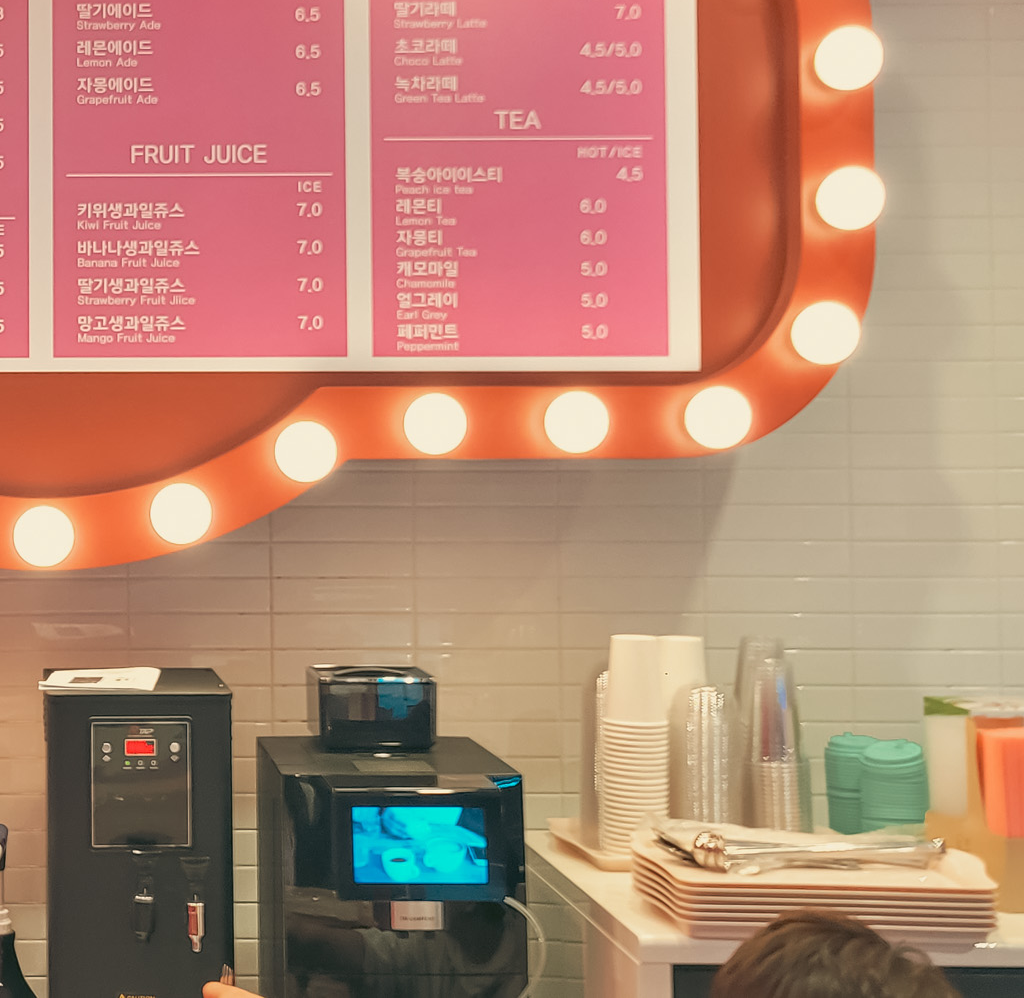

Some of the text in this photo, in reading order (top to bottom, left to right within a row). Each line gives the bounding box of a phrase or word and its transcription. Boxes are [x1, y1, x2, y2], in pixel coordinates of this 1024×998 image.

[77, 3, 152, 19] 딸기에이드
[295, 7, 320, 22] 6.5
[394, 1, 456, 17] 딸기라떼
[615, 4, 641, 20] 7.0
[77, 20, 161, 31] Strawberry Ade
[77, 40, 153, 55] 레몬에이드
[296, 44, 321, 59] 6.5
[395, 38, 457, 54] 초코라떼
[580, 42, 642, 58] 4.5/5.0
[77, 58, 137, 67] Lemon Ade
[77, 78, 154, 93] 자몽에이드
[296, 82, 321, 96] 6.5
[395, 76, 458, 92] 녹차라떼
[580, 79, 642, 95] 4.5/5.0
[77, 95, 158, 106] Grapefruit Ade
[494, 110, 541, 129] TEA
[131, 144, 267, 163] FRUIT JUICE
[578, 146, 642, 158] HOT/ICE
[616, 166, 643, 181] 4.5
[298, 181, 321, 192] ICE
[78, 203, 184, 219] 키위생과일쥬스
[297, 202, 322, 217] 7.0
[580, 199, 607, 214] 6.0
[78, 220, 161, 229] Kiwi Fruit Juice
[580, 230, 607, 245] 6.0
[78, 240, 200, 256] 바나나생과일쥬스
[297, 240, 322, 255] 7.0
[78, 258, 180, 267] Banana Fruit Juice
[581, 262, 607, 276] 5.0
[78, 278, 185, 294] 딸기생과일쥬스
[297, 278, 323, 292] 7.0
[78, 295, 136, 306] Strawberry
[141, 295, 165, 305] Fruit
[581, 293, 608, 308] 5.0
[78, 316, 186, 332] 망고생과일쥬스
[298, 316, 323, 330] 7.0
[78, 333, 176, 344] Mango Fruit Juice
[582, 324, 608, 339] 5.0
